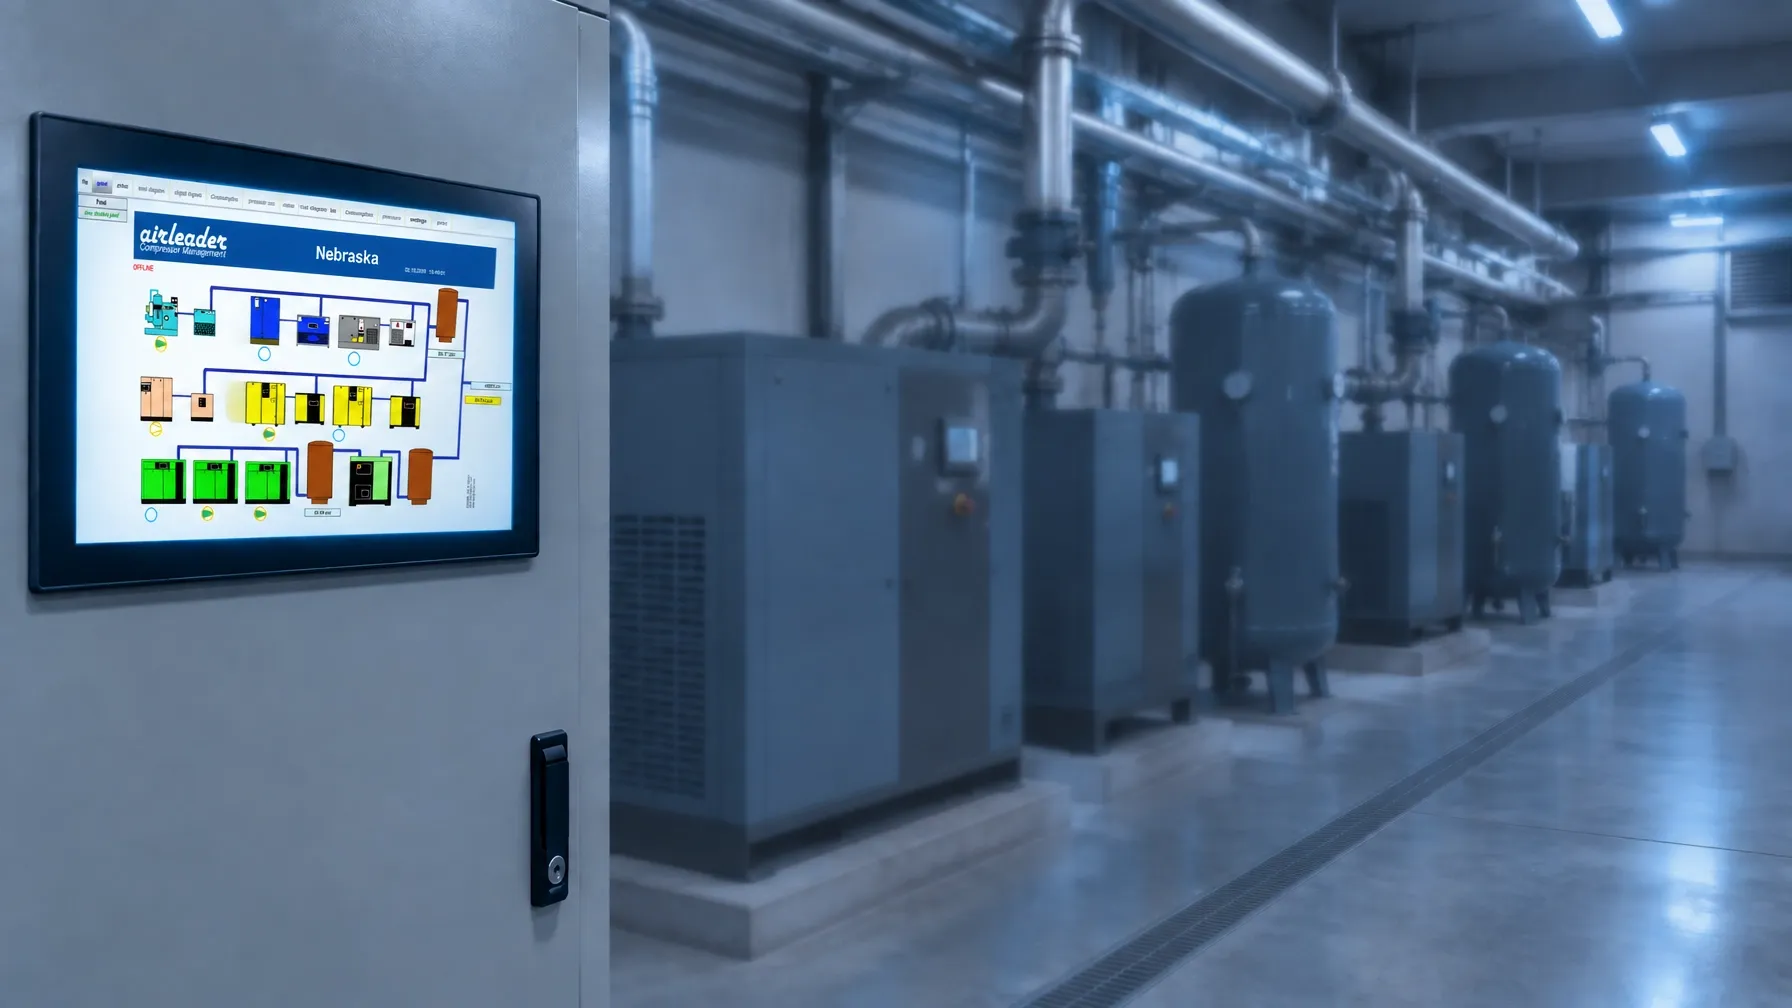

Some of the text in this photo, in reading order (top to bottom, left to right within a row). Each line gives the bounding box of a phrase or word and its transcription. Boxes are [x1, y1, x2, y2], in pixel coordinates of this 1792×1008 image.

[140, 222, 228, 250] airleader
[139, 242, 227, 259] Compressor Management
[315, 245, 379, 265] Nebraska
[132, 263, 154, 272] OFFLINE
